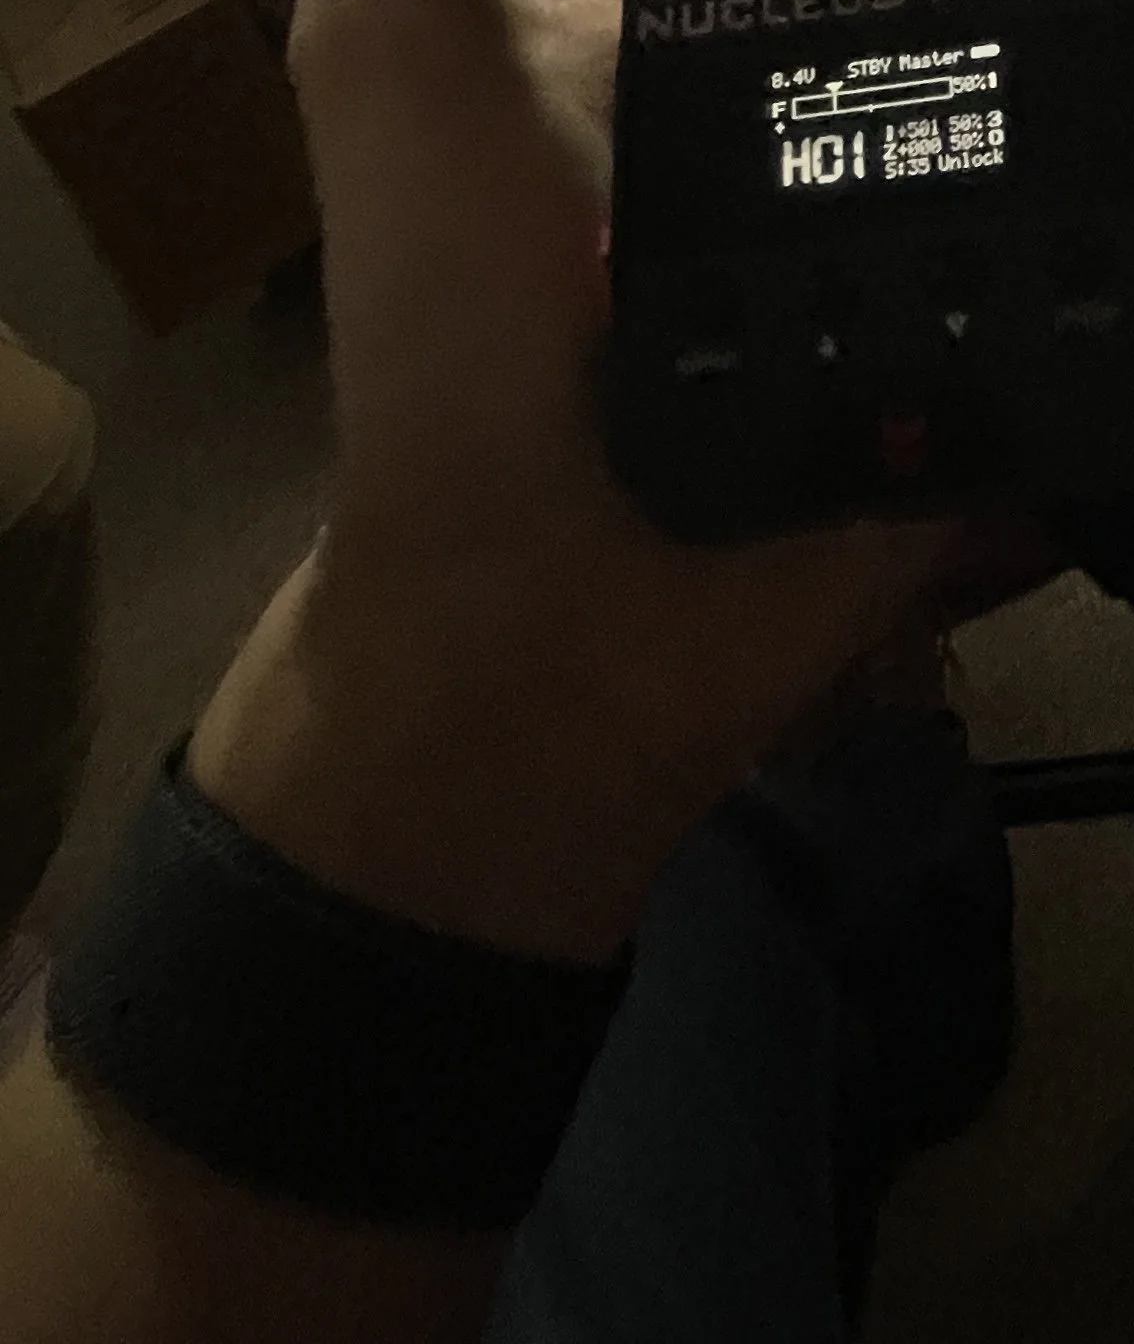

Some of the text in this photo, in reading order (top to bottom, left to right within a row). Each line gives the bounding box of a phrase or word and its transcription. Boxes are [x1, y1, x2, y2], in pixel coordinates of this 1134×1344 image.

[846, 56, 893, 79] STBY
[898, 50, 965, 72] Master
[771, 100, 787, 119] F
[937, 147, 1004, 172] Unlock
